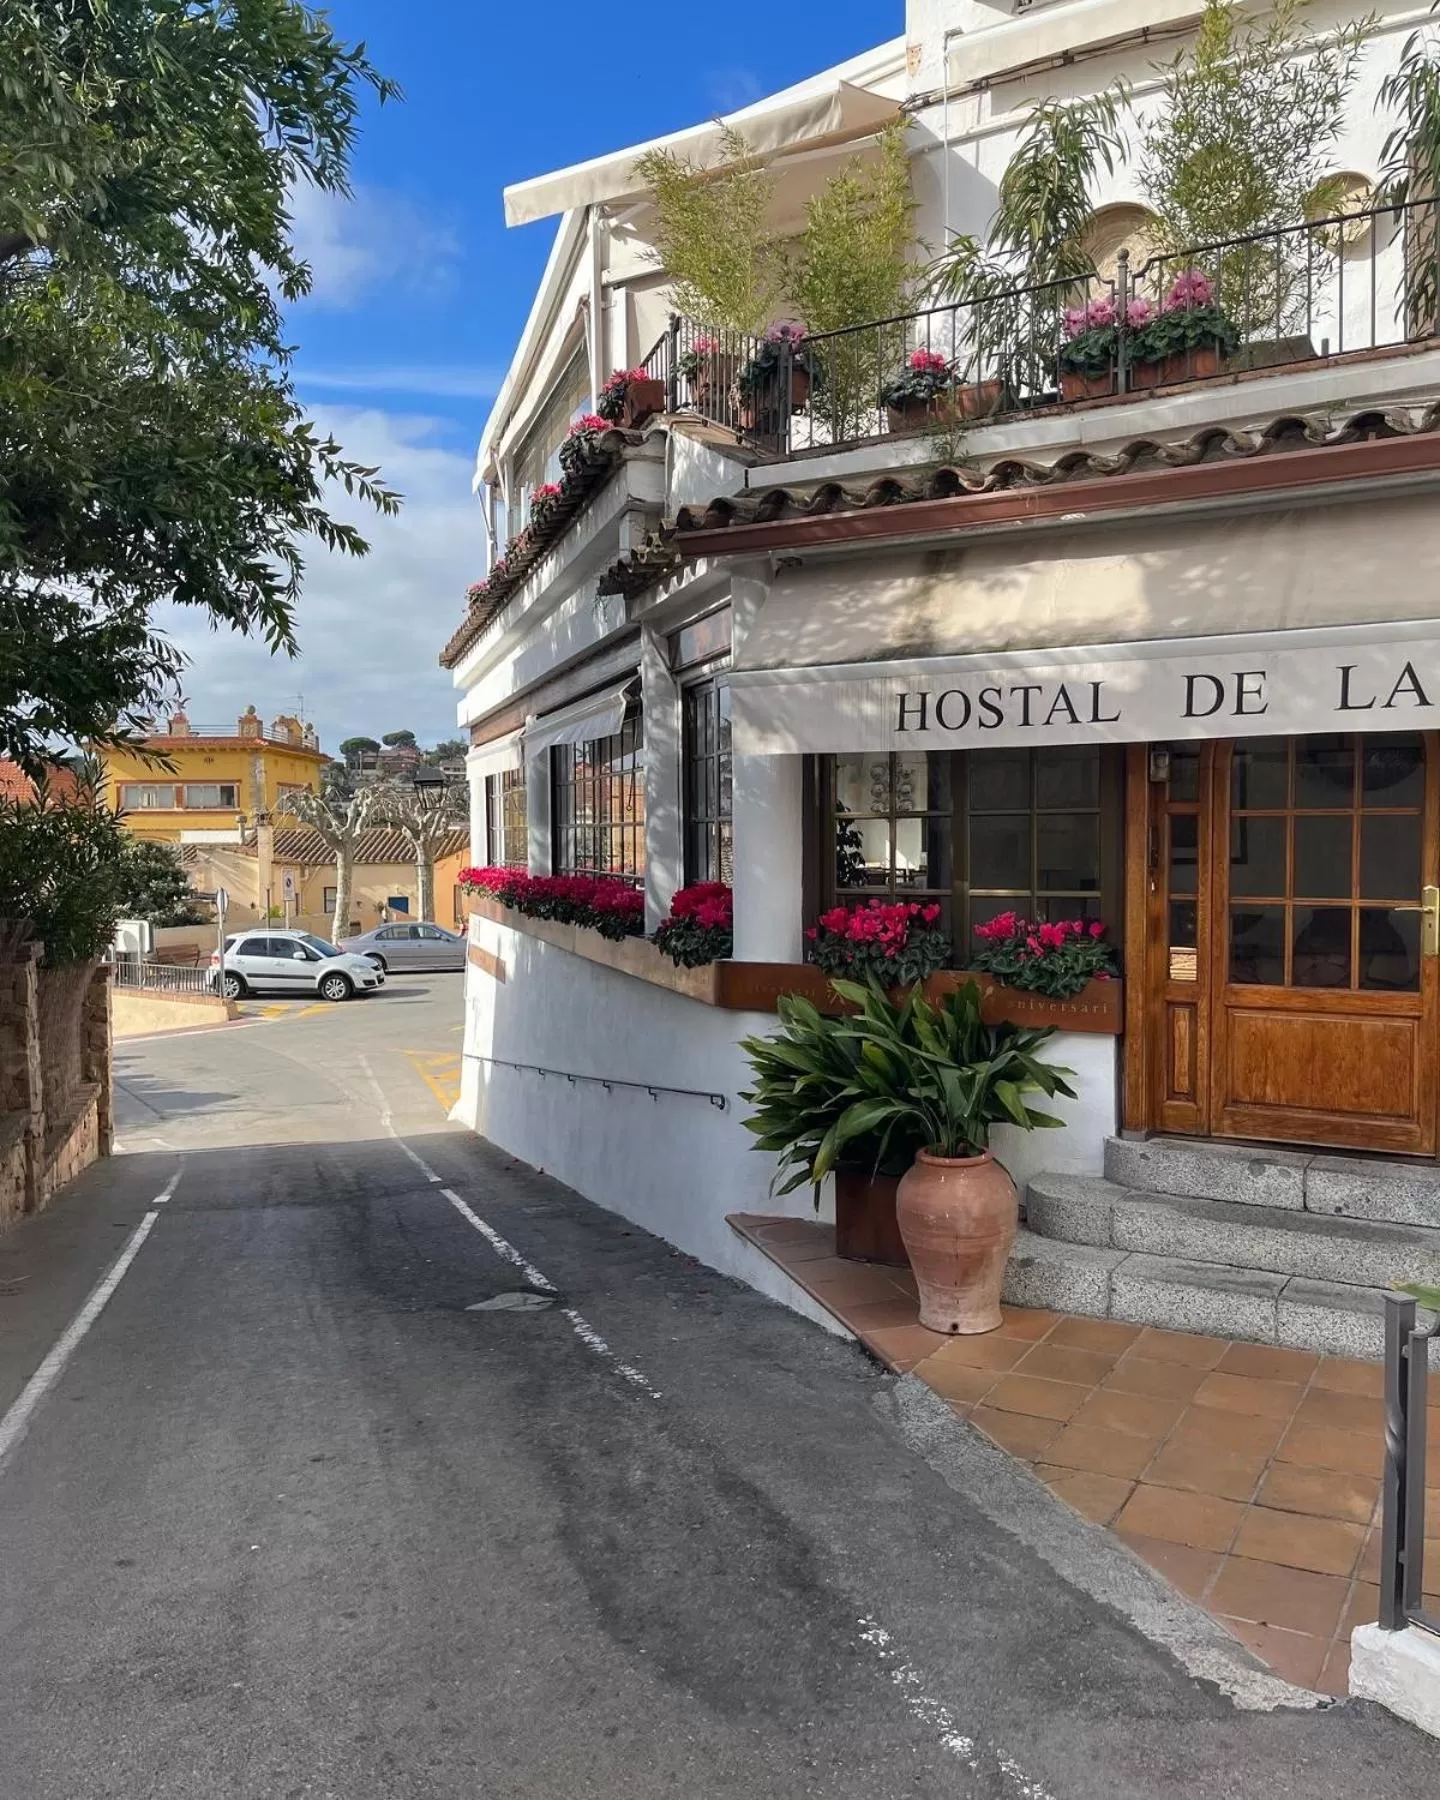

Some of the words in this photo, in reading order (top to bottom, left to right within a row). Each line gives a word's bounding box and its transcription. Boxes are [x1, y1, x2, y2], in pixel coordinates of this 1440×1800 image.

[894, 681, 1121, 733] HOSTAL
[1181, 670, 1269, 718] DE
[1335, 660, 1435, 711] LA
